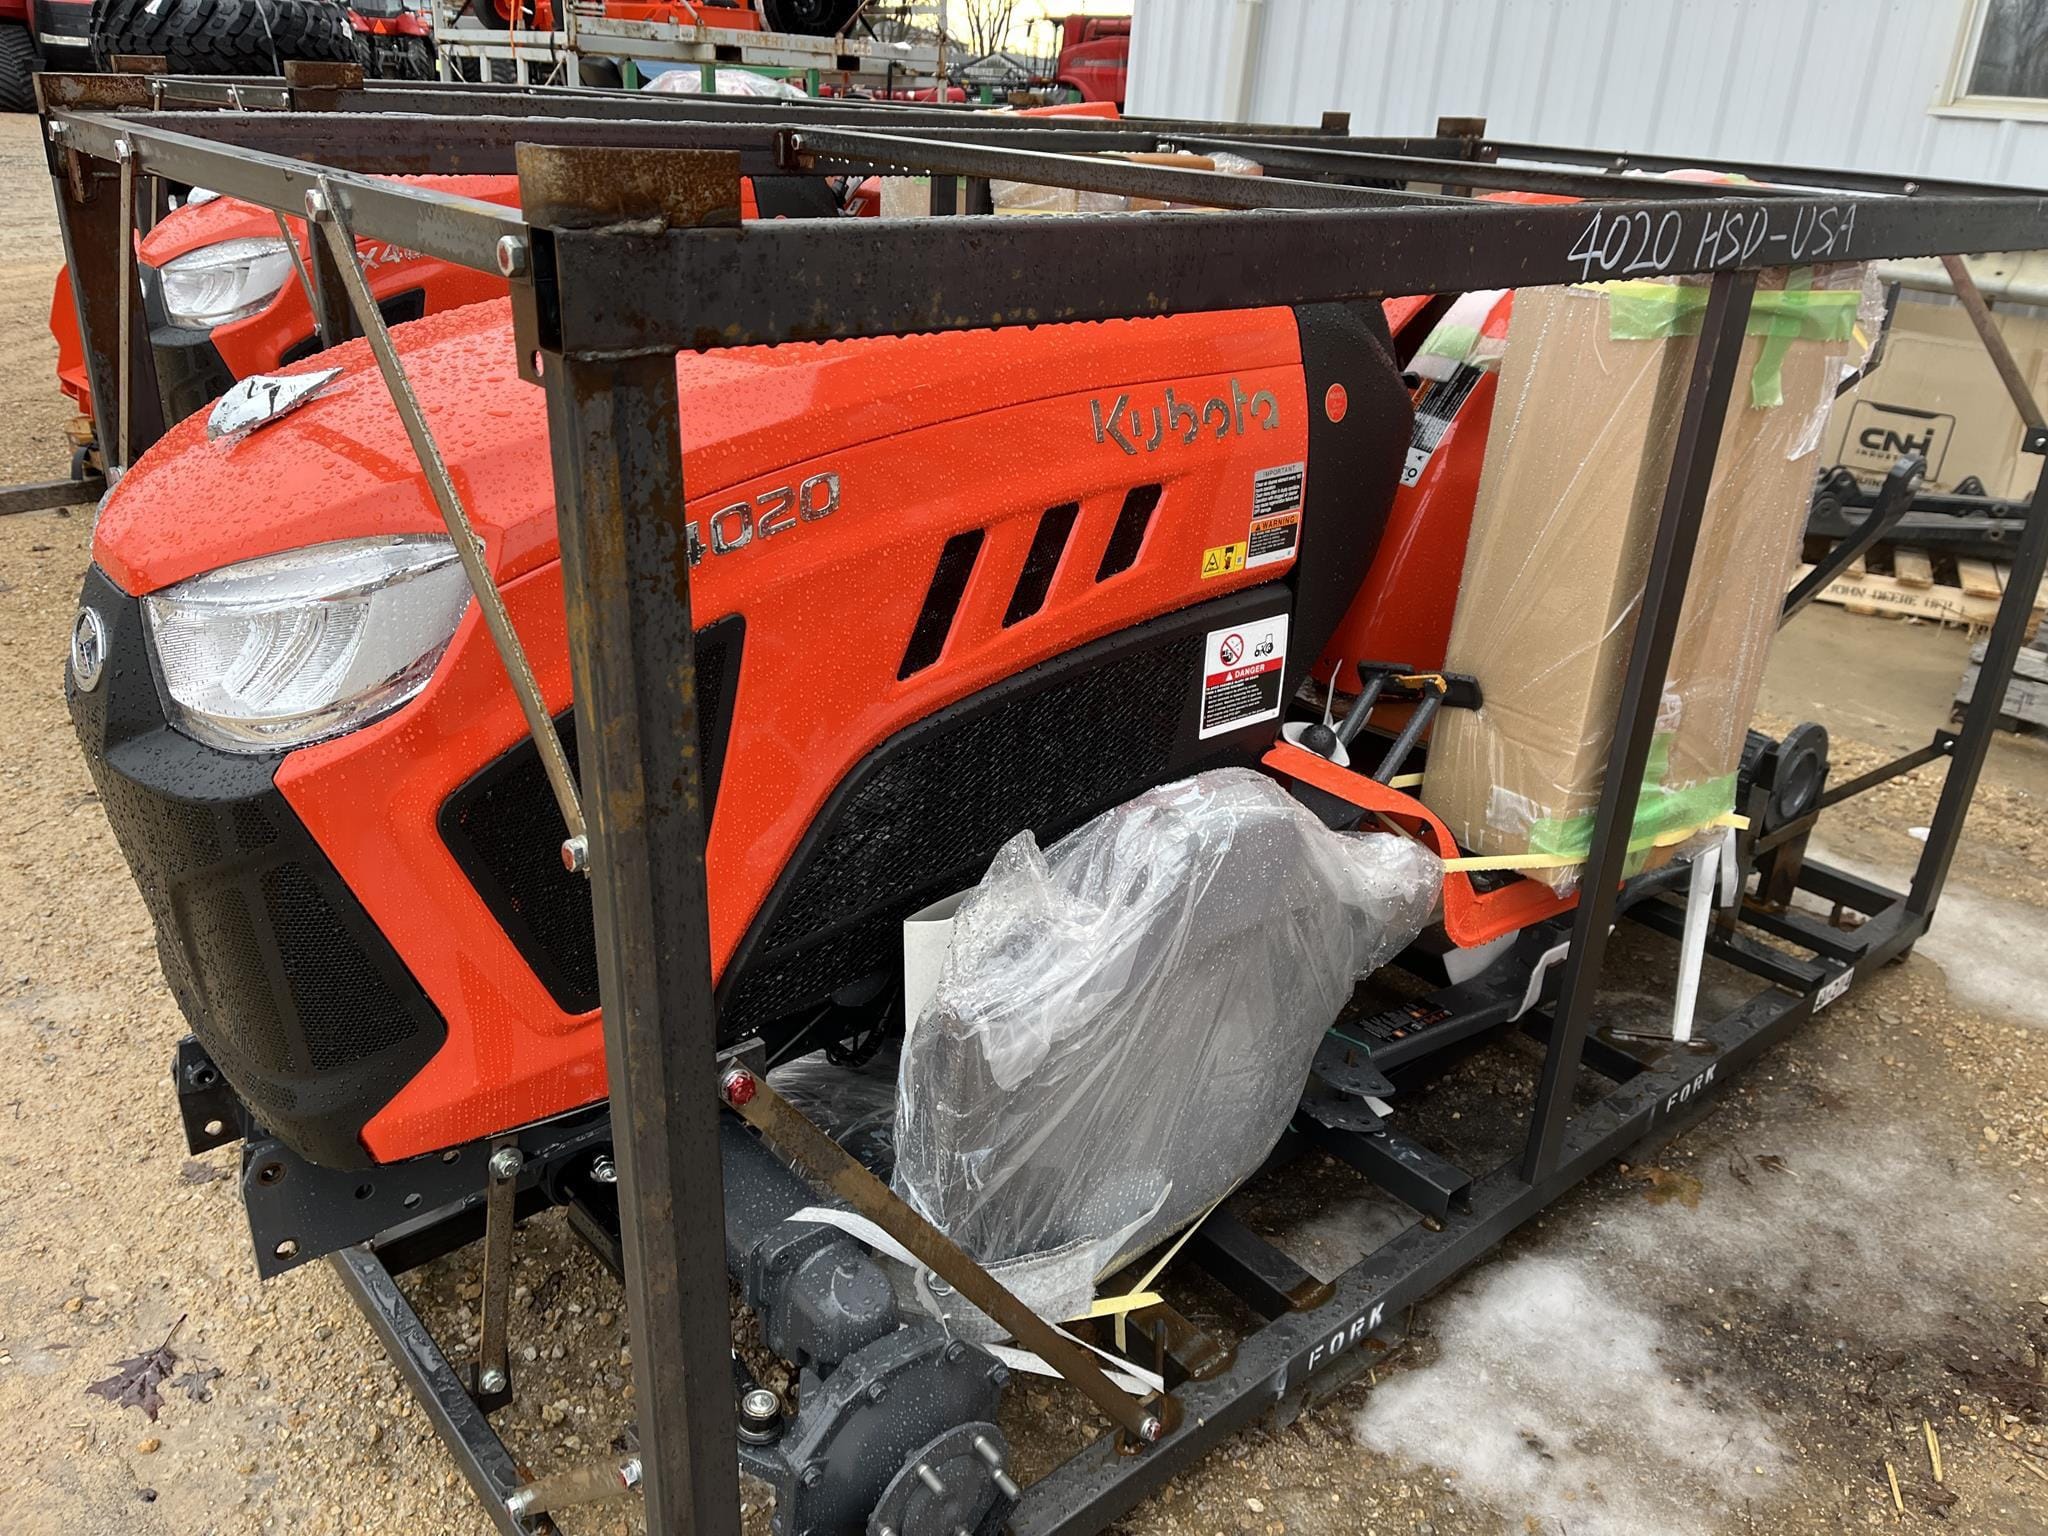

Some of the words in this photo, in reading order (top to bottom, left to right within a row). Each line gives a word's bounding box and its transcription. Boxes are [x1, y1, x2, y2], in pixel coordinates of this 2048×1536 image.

[1567, 207, 1682, 280] 4020
[1694, 203, 1857, 269] HSD-USA
[1090, 377, 1280, 455] Kubota
[1262, 464, 1296, 477] IMPORTANT
[1262, 515, 1295, 529] WARNING
[1234, 663, 1265, 679] DANGER
[1666, 1063, 1718, 1113] FORK
[1308, 1301, 1385, 1371] FORK
